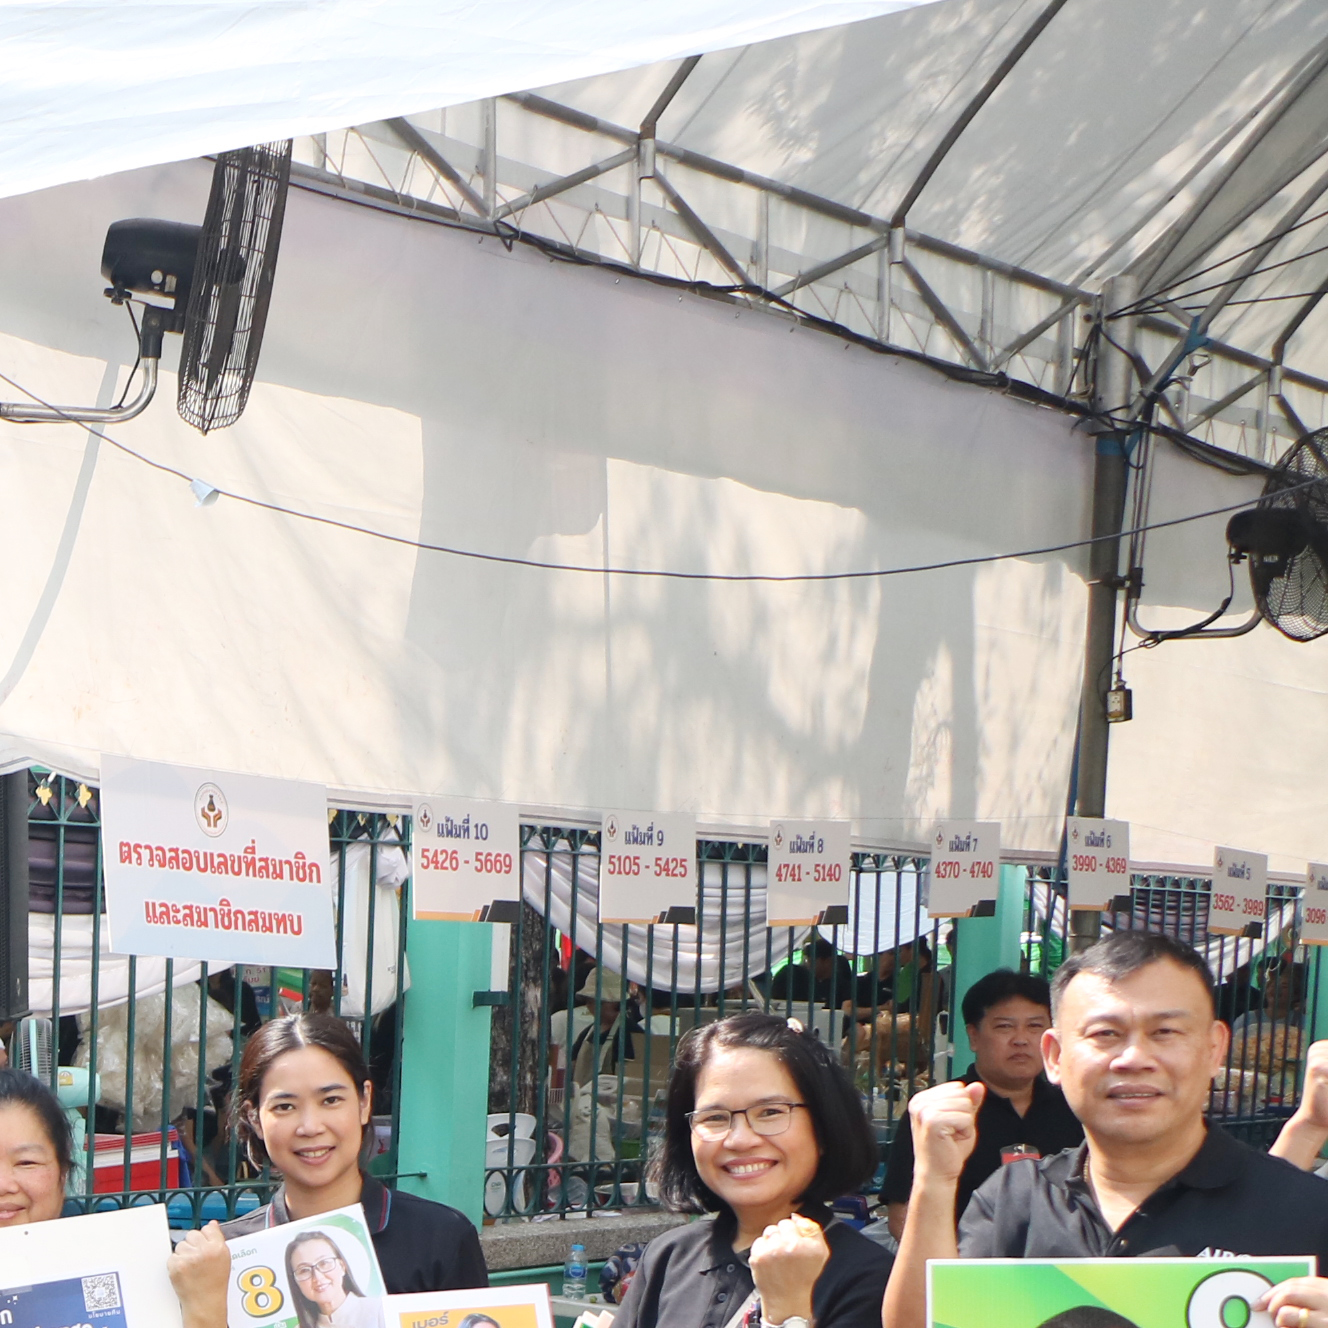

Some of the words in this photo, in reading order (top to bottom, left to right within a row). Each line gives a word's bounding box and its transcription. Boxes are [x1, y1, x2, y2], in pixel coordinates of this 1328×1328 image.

[436, 817, 470, 840] แฟ้มที่
[474, 823, 489, 841] 10
[625, 822, 654, 846] แฟ้มที่
[656, 830, 664, 846] 9
[119, 839, 322, 885] ตรวจสอบเลขที่สมาชิก
[420, 848, 459, 871] 5426
[474, 850, 512, 874] 5669
[607, 855, 641, 876] 5105
[654, 858, 688, 878] 5425
[776, 863, 802, 882] 4741
[814, 863, 841, 882] 5140
[935, 861, 960, 878] 4370
[969, 861, 993, 878] 4740
[1073, 855, 1096, 872] 3990
[1106, 857, 1126, 873] 4369
[1213, 893, 1235, 911] 3562
[1243, 898, 1264, 916] 3989
[1306, 908, 1326, 924] 3096
[144, 897, 303, 937] และสมาชิกสมทบ
[237, 1265, 284, 1318] 8
